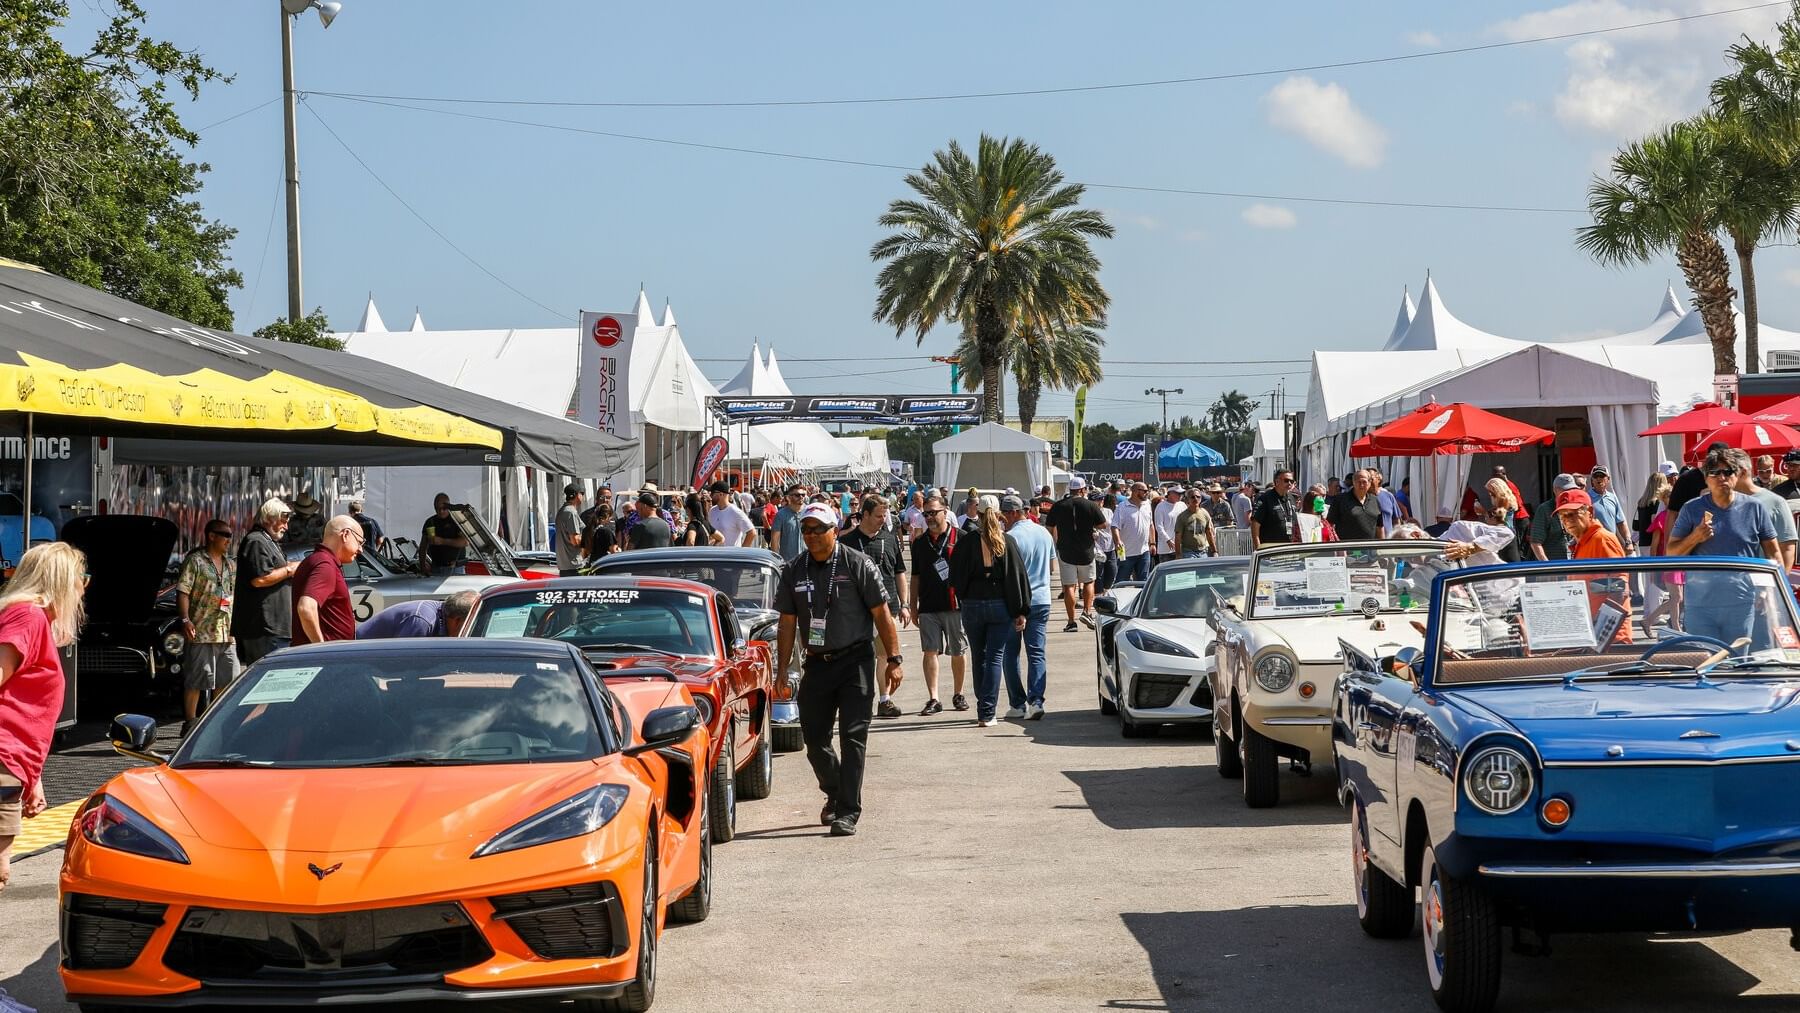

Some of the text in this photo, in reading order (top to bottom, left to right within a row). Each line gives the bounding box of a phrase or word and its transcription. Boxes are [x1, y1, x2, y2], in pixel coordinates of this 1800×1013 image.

[59, 378, 96, 408] Reflect
[117, 386, 145, 412] Passion
[910, 400, 968, 408] BluePrint
[1114, 441, 1145, 460] For
[1099, 473, 1123, 481] FORD
[535, 590, 640, 600] 302 STROKER
